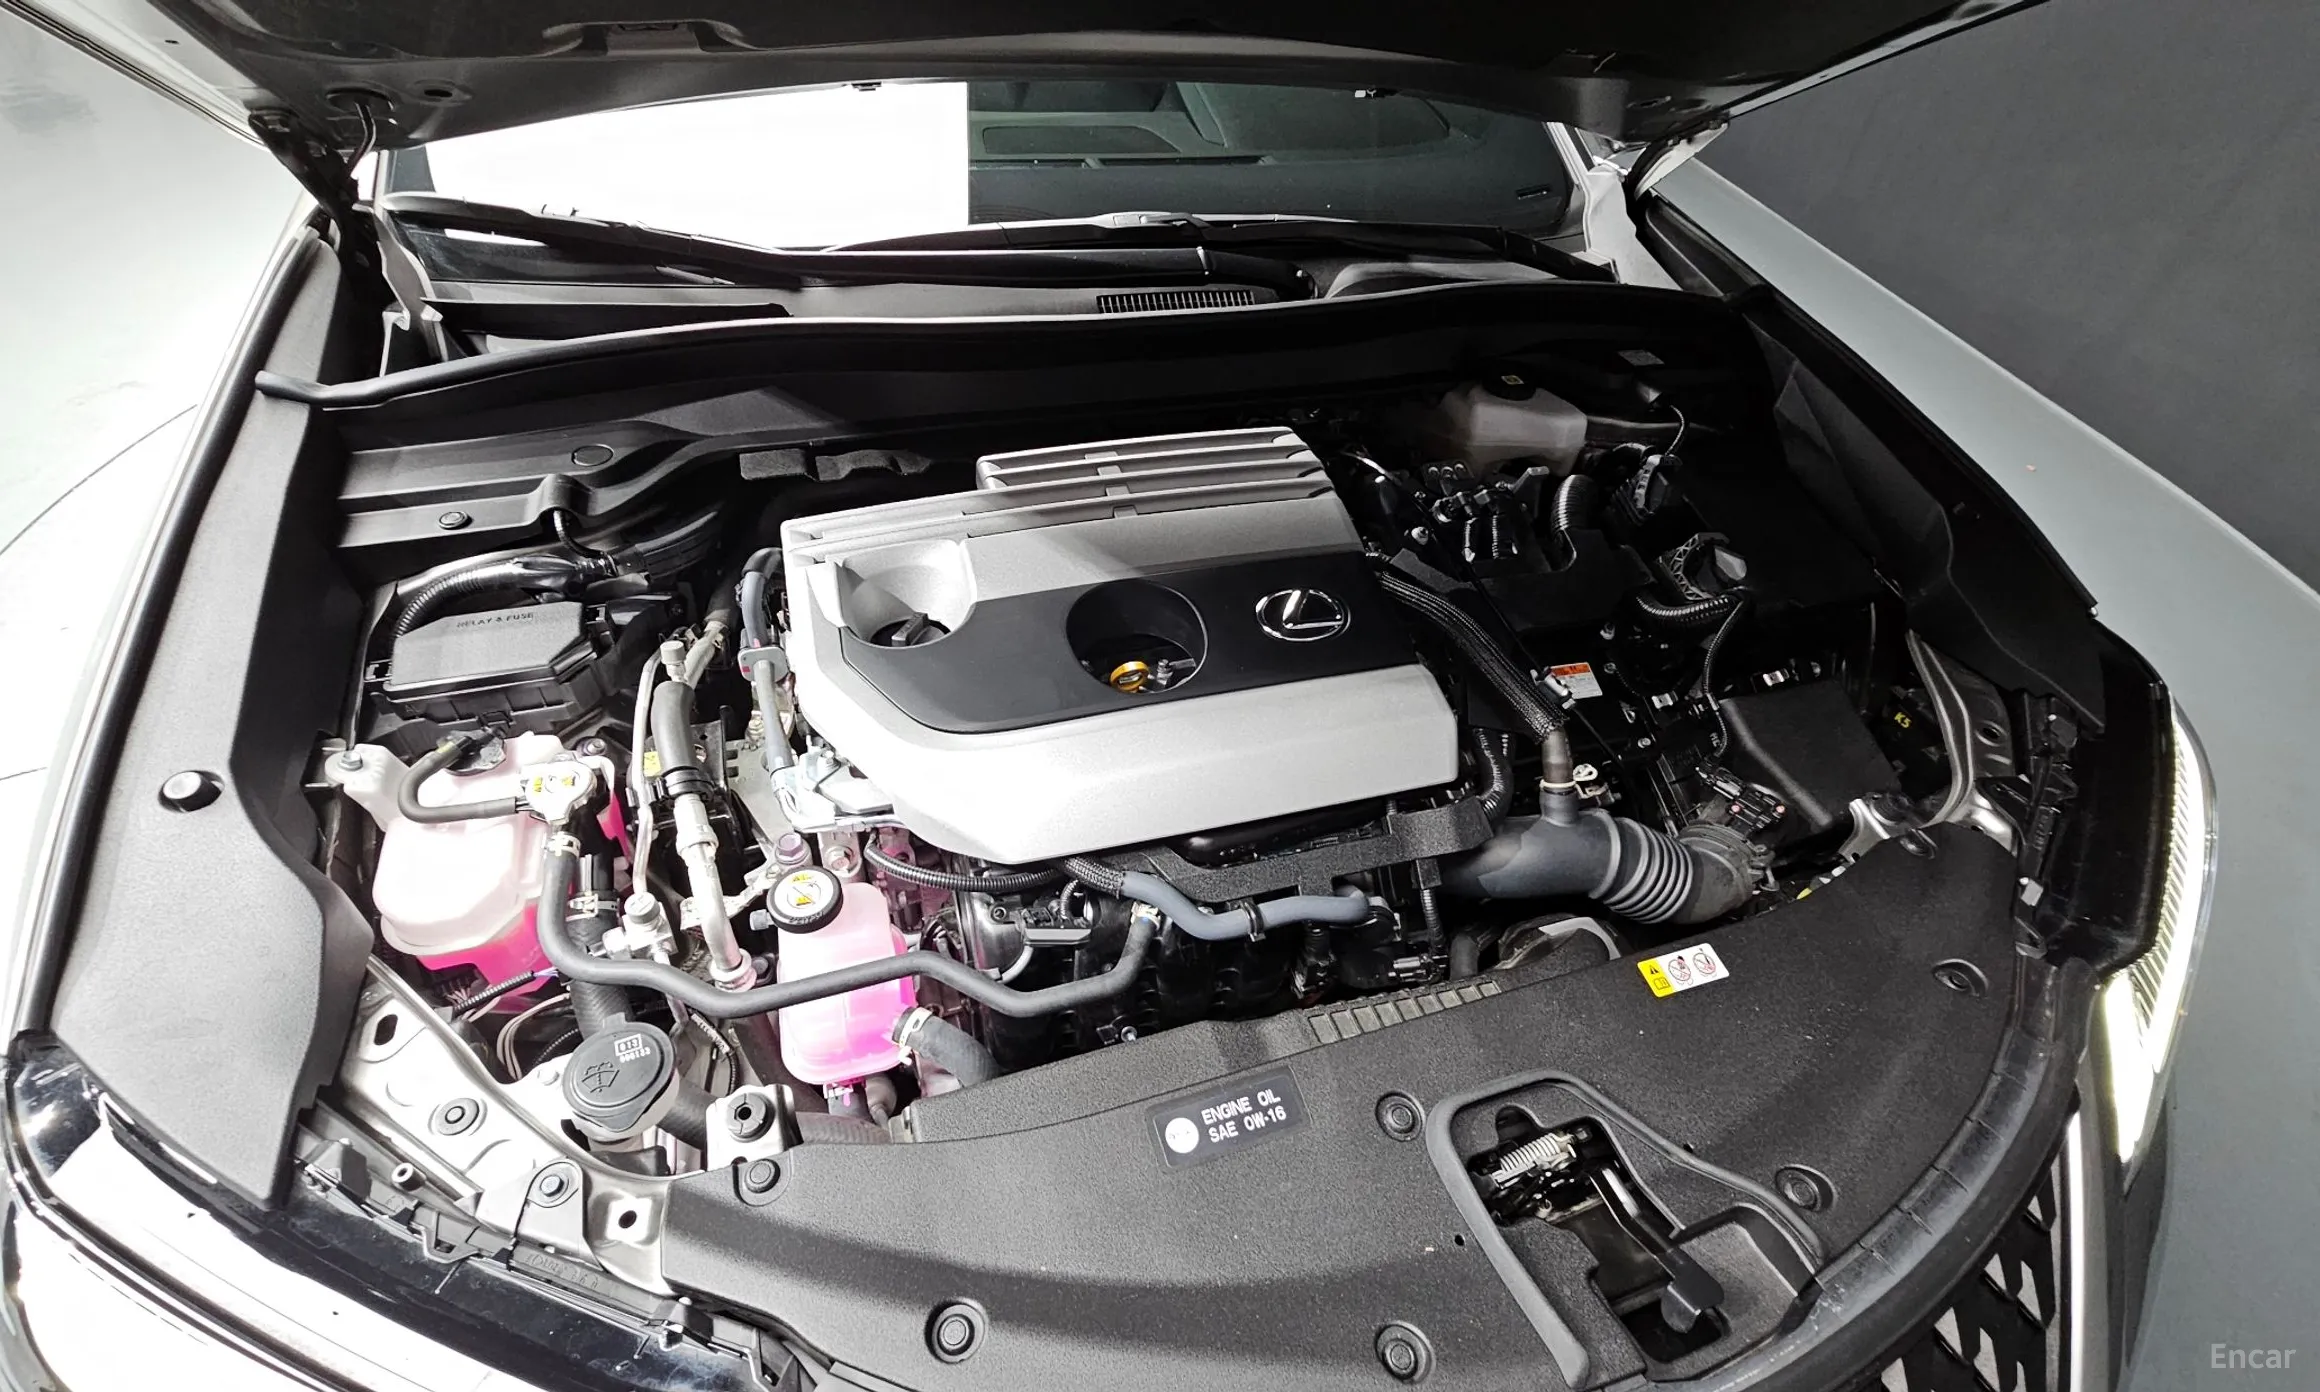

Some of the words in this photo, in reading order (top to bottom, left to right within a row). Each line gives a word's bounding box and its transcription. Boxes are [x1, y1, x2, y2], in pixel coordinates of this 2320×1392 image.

[506, 613, 534, 621] FUSE
[1201, 1096, 1253, 1125] ENGINE
[1256, 1088, 1281, 1107] OIL
[1208, 1121, 1239, 1143] SAE
[1243, 1105, 1287, 1131] 0W-16
